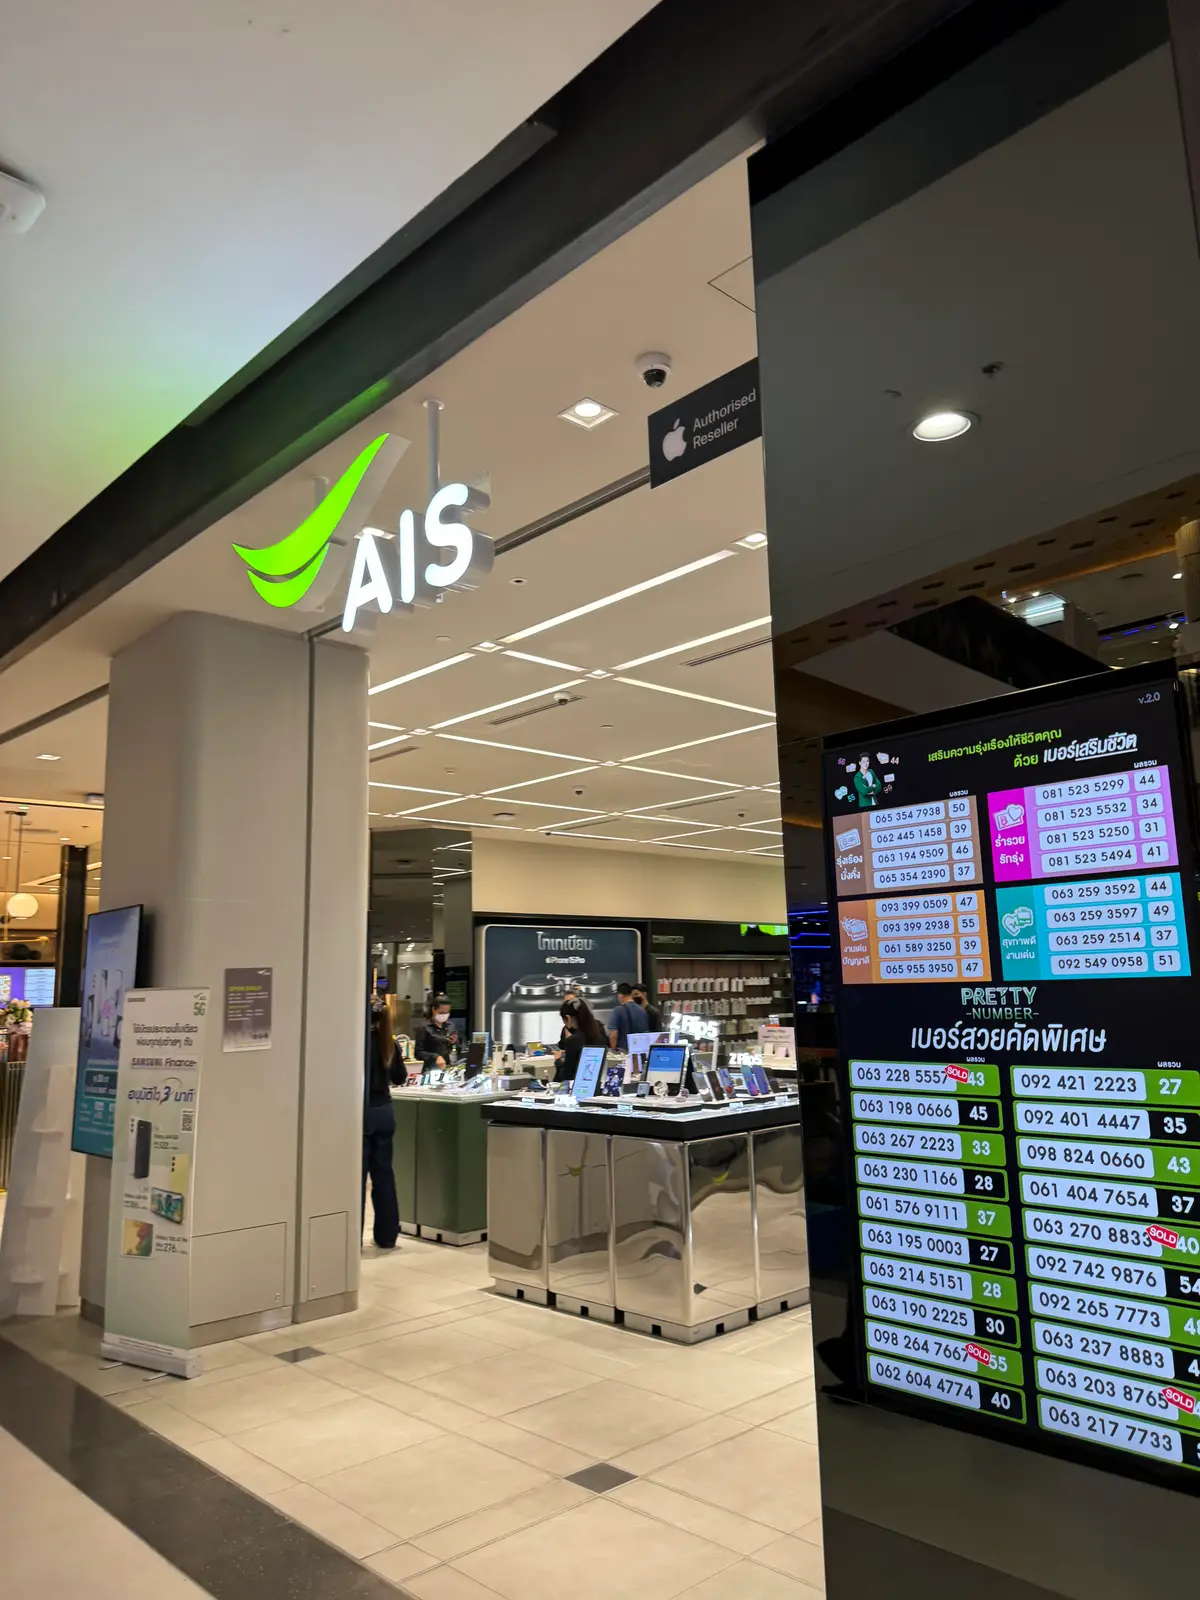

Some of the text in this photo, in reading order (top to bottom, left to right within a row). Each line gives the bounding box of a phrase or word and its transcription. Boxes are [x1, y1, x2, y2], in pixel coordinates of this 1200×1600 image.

[693, 388, 756, 432] Authorised
[693, 418, 738, 449] Reseller
[342, 483, 474, 632] AIS
[1138, 692, 1160, 704] v.2.0
[1013, 732, 1138, 768] ด้วย เบอร์เสริมชีวิต
[1042, 775, 1155, 800] 081 523 5299 44
[875, 803, 965, 824] 065 354 7938 50
[995, 834, 1025, 848] ร่ำรวย
[1000, 853, 1024, 866] รักรุ่ง
[1048, 846, 1161, 867] 081 523 5494 41
[879, 866, 970, 884] 065 354 2390 37
[1051, 881, 1166, 900] 063 259 3592 44
[881, 897, 972, 913] 093 399 0509 47
[1002, 936, 1036, 947] สุขภาพดี
[1006, 951, 1035, 960] งานเด่น
[1058, 955, 1173, 969] 092 549 0958 51
[885, 962, 978, 974] 065 955 3950 47
[961, 986, 1037, 1006] PRETTY
[194, 1002, 206, 1016] 5G
[911, 1020, 1107, 1053] เบอร์สวยคัดพิเศษ
[132, 1058, 162, 1066] SAMSUNG
[947, 1066, 968, 1080] SOLD
[857, 1067, 985, 1086] 063 228 5557 43
[1021, 1074, 1182, 1095] 092 421 2223 27
[175, 1088, 194, 1102] นาที
[859, 1098, 988, 1121] 063 198 0666 45
[1024, 1109, 1187, 1134] 092 401 4447 35
[861, 1130, 990, 1155] 063 267 2223 33
[1027, 1144, 1190, 1174] 098 824 0660 43
[864, 1163, 993, 1190] 063 230 1166 28
[1030, 1181, 1194, 1214] 061 404 7654 37
[866, 1196, 996, 1226] 061 576 9111 37
[868, 1228, 998, 1262] 063 195 0003 27
[1033, 1217, 1200, 1254] 063 270 8833 40
[1150, 1228, 1176, 1244] SOLD
[870, 1261, 1001, 1298] 063 214 5151 28
[1036, 1254, 1200, 1296] 092 742 9876 54
[872, 1294, 1004, 1335] 063 190 2225 30
[1039, 1291, 1071, 1312] 092
[1076, 1298, 1109, 1318] 265
[1114, 1304, 1160, 1328] 7773
[874, 1328, 1008, 1372] 098 264 7667 55
[967, 1344, 990, 1362] SOLD
[1042, 1329, 1074, 1350] 063
[1080, 1337, 1112, 1357] 237
[1119, 1345, 1164, 1368] 8883
[876, 1362, 1011, 1409] 062 604 4774 40
[1045, 1367, 1077, 1388] 063
[1083, 1376, 1116, 1398] 203
[1123, 1385, 1170, 1410] 8765
[1166, 1389, 1193, 1408] SOLD
[1048, 1406, 1080, 1428] 063
[1086, 1416, 1119, 1437] 217
[1126, 1424, 1172, 1451] 7733
